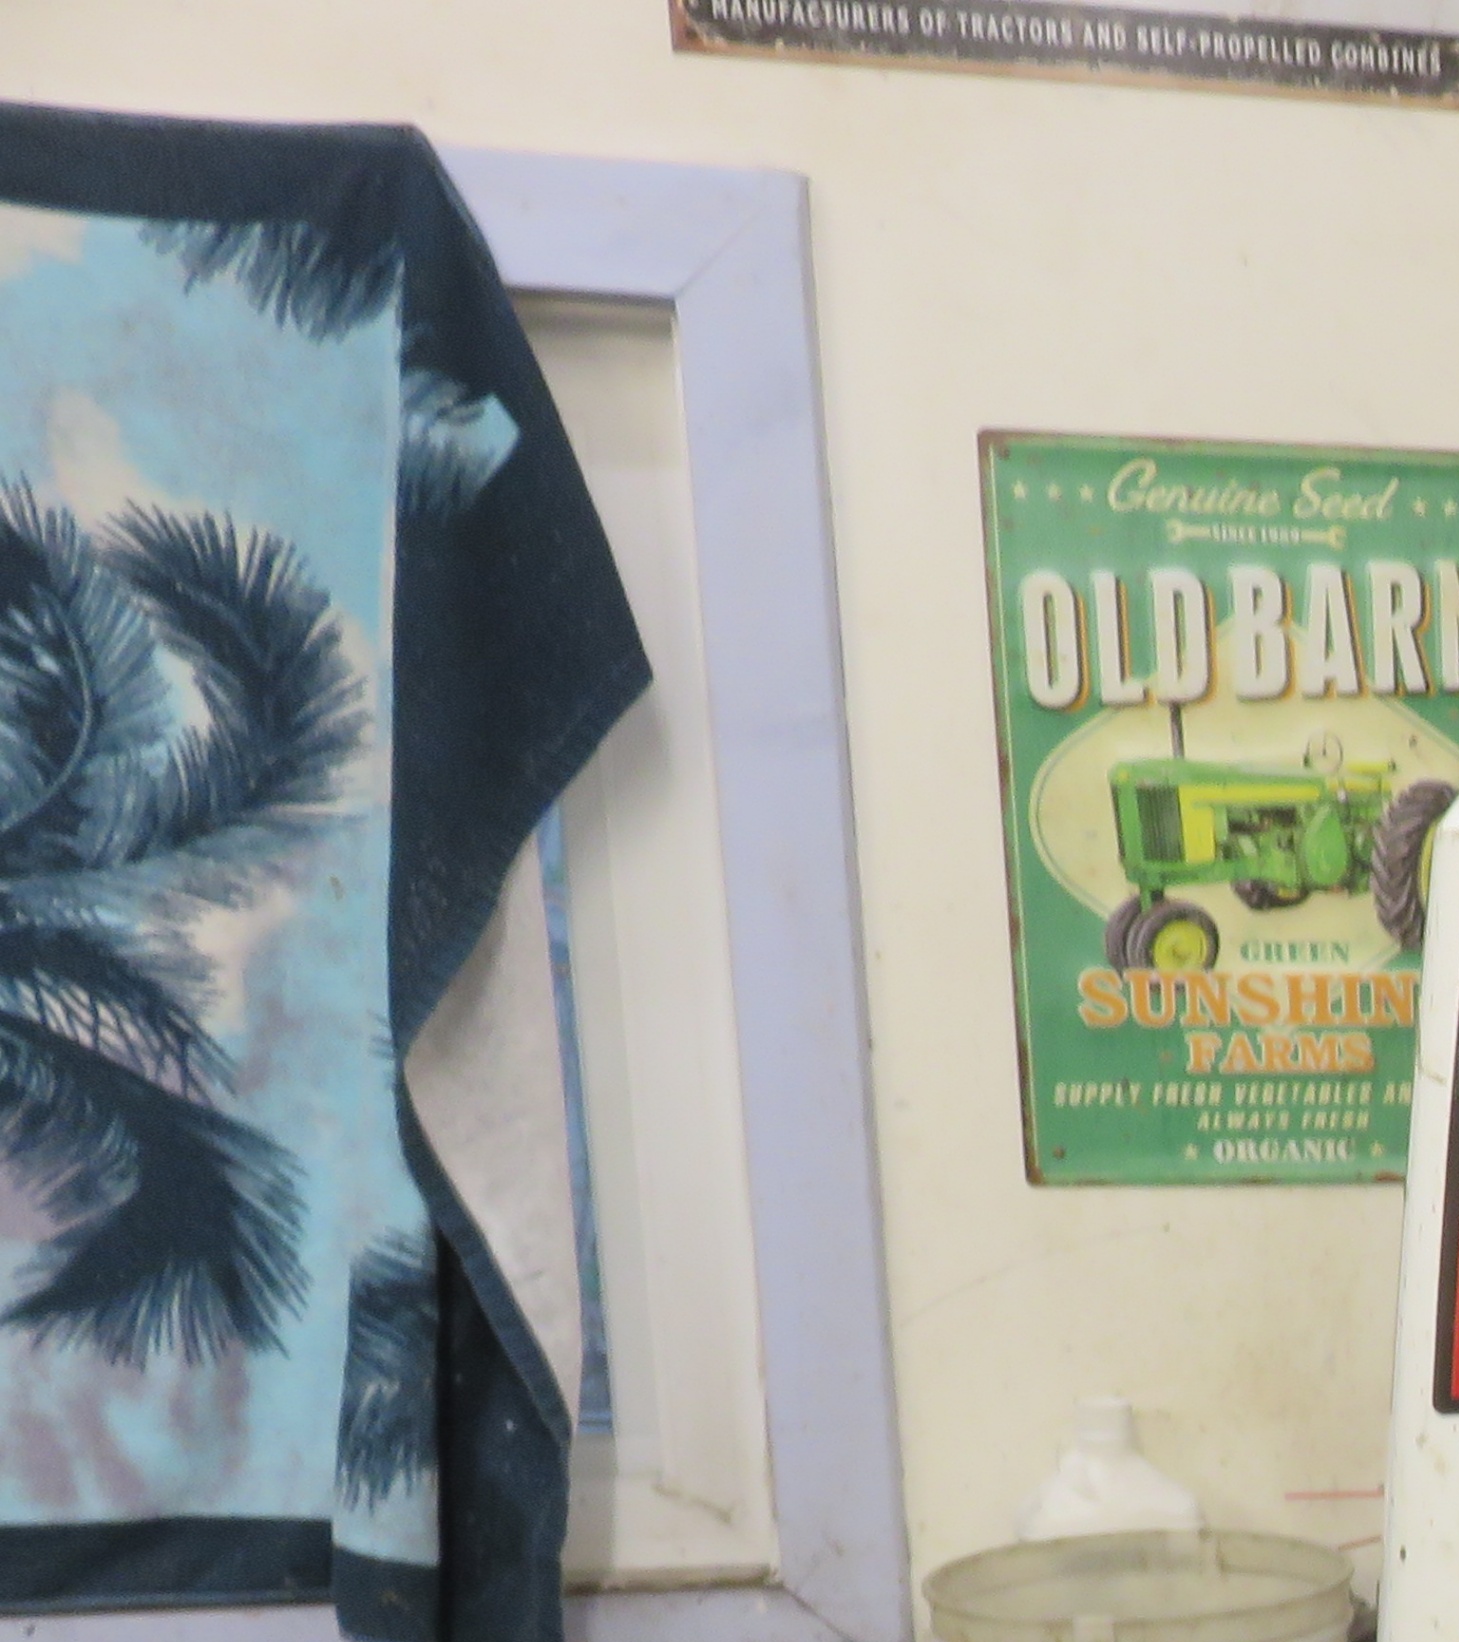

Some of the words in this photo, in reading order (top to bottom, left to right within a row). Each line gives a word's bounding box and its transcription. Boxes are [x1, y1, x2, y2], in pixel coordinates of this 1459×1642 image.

[712, 0, 909, 35] MANUFACTURERS
[919, 9, 947, 37] OF
[956, 10, 1073, 48] TRACTORS
[1083, 21, 1127, 52] AND
[1331, 40, 1442, 77] COMBINES
[1108, 458, 1281, 514] Genuine
[1293, 467, 1400, 521] Seed
[1240, 940, 1351, 964] GREEN
[1078, 968, 1419, 1029] SUNSHIN
[1186, 1031, 1377, 1075] FARMS
[1212, 1138, 1352, 1164] ORGANIC
